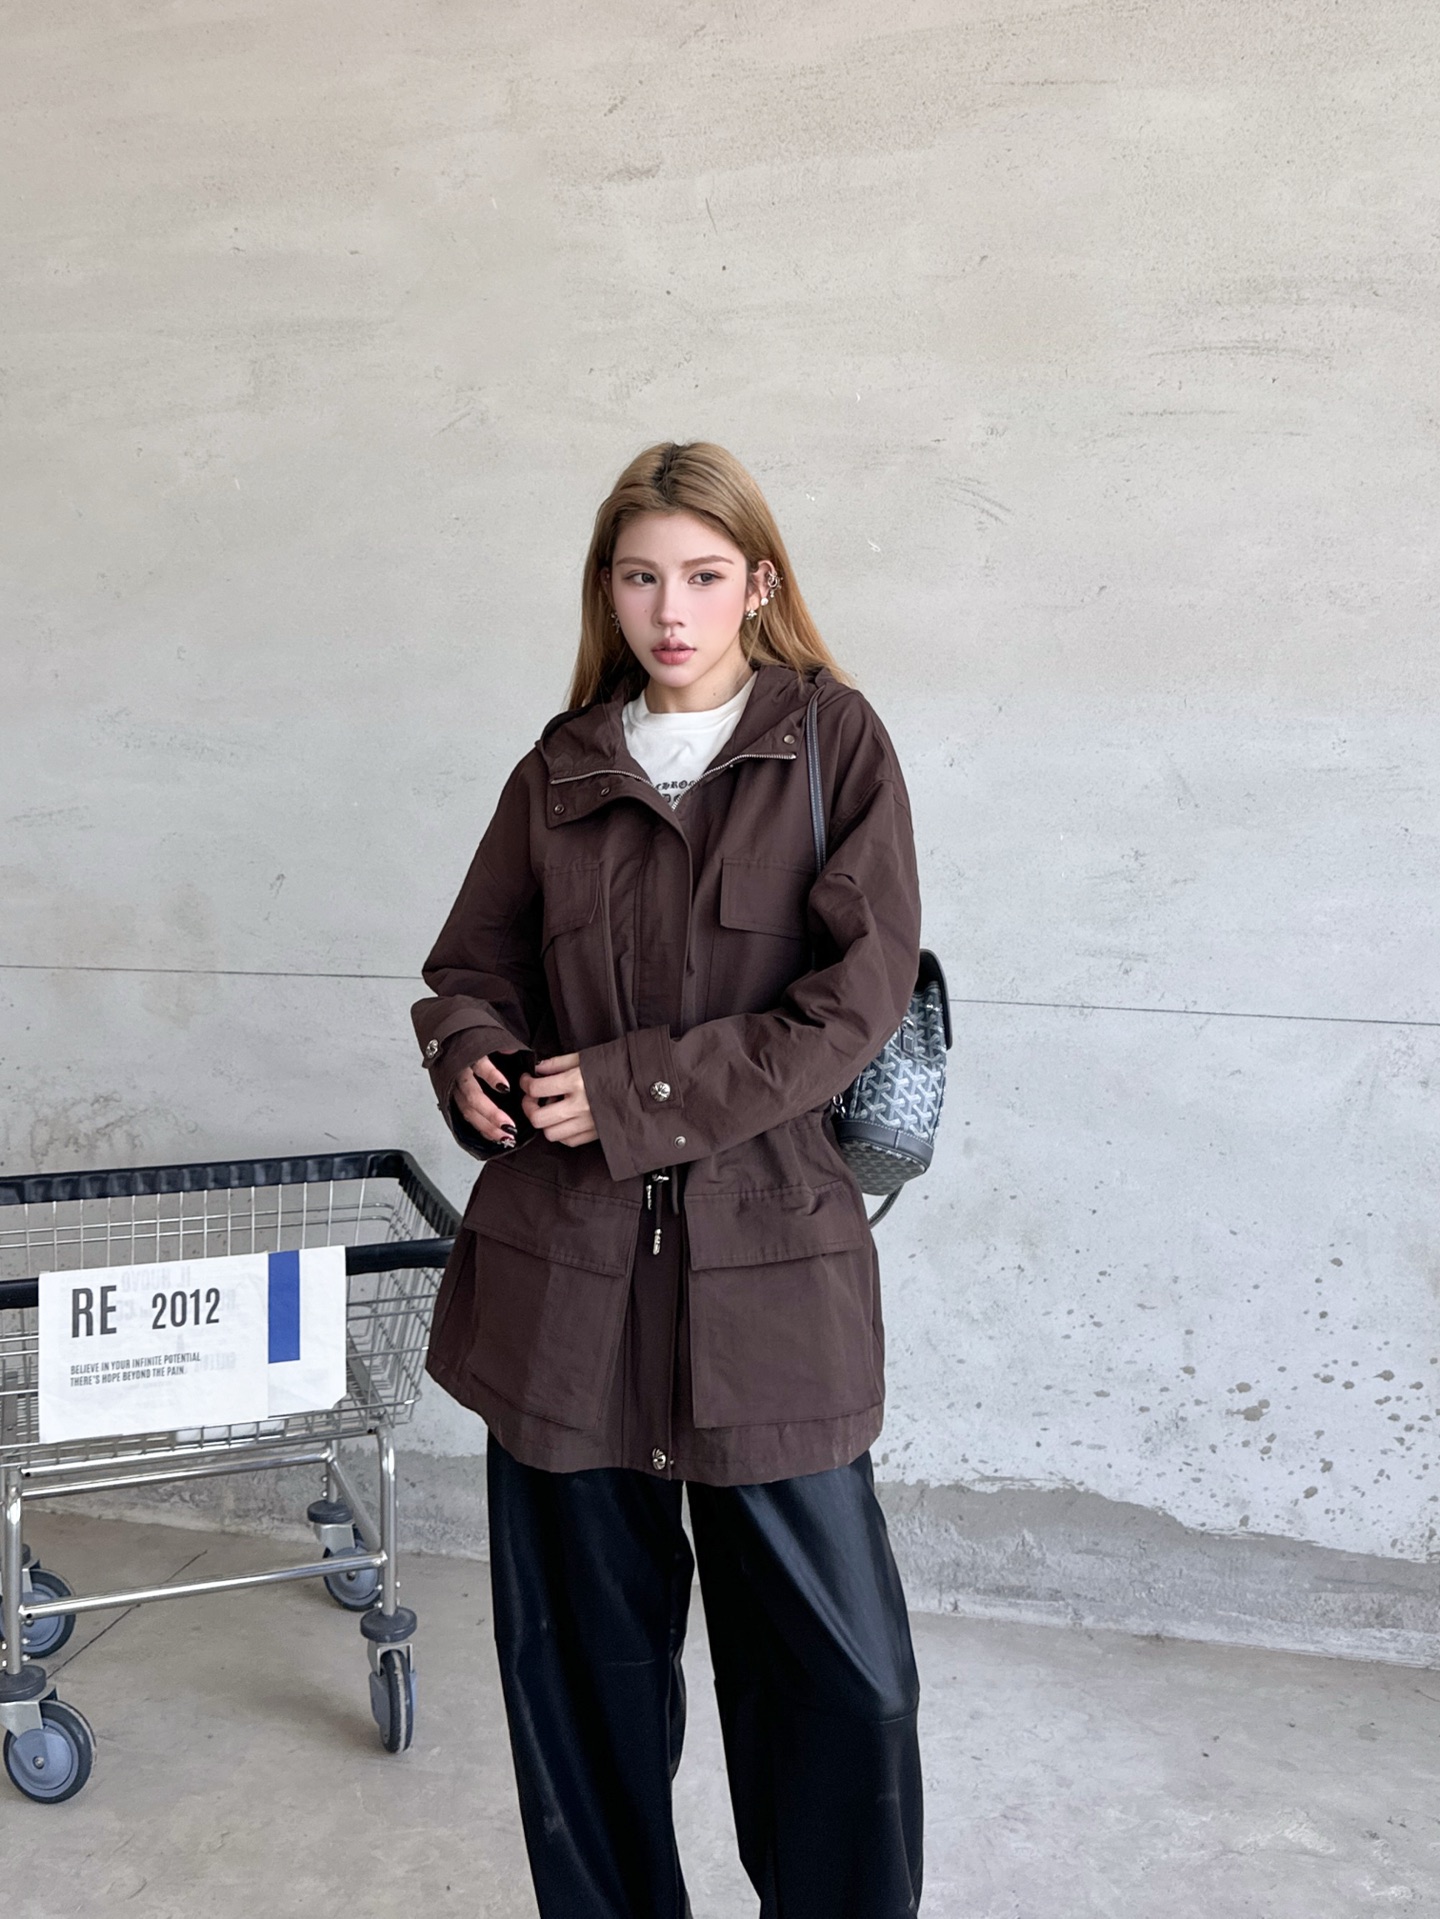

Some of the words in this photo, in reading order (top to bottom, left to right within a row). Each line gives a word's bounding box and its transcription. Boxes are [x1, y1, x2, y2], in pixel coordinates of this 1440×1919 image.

[71, 1284, 117, 1338] RE
[151, 1287, 221, 1330] 2012
[70, 1362, 100, 1375] BELIEVE
[101, 1361, 110, 1372] IN
[111, 1359, 131, 1370] YOUR
[132, 1355, 162, 1368] INFINITE
[164, 1352, 201, 1365] POTENTIAL
[70, 1374, 101, 1387] THERE'S
[101, 1372, 121, 1383] HOPE
[122, 1369, 151, 1381] BEYOND
[152, 1367, 165, 1378] THE
